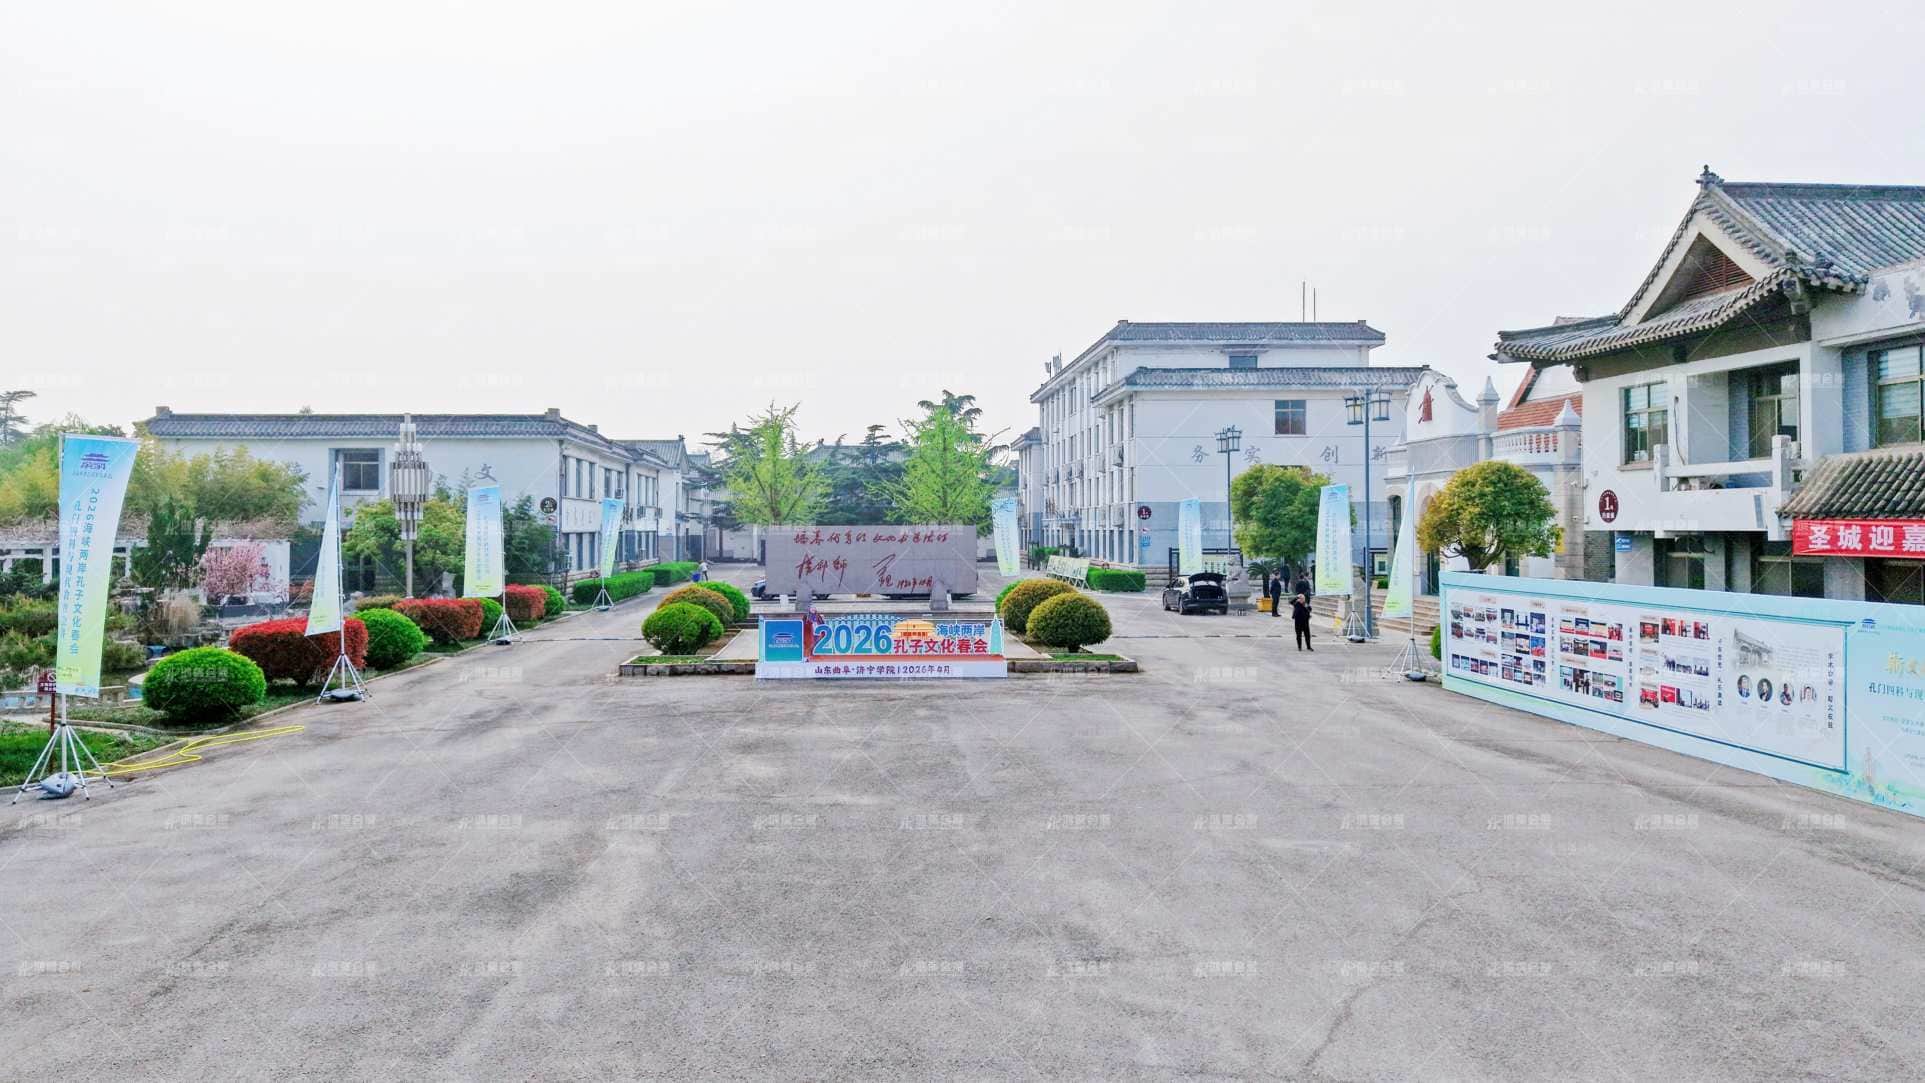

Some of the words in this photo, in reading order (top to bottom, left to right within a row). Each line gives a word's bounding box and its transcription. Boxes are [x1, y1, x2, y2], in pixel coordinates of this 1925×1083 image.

[1808, 524, 1925, 552] 圣城迎嘉
[814, 624, 892, 654] 2026
[936, 623, 985, 637] 海峡两岸
[894, 638, 988, 654] 孔子文化春会
